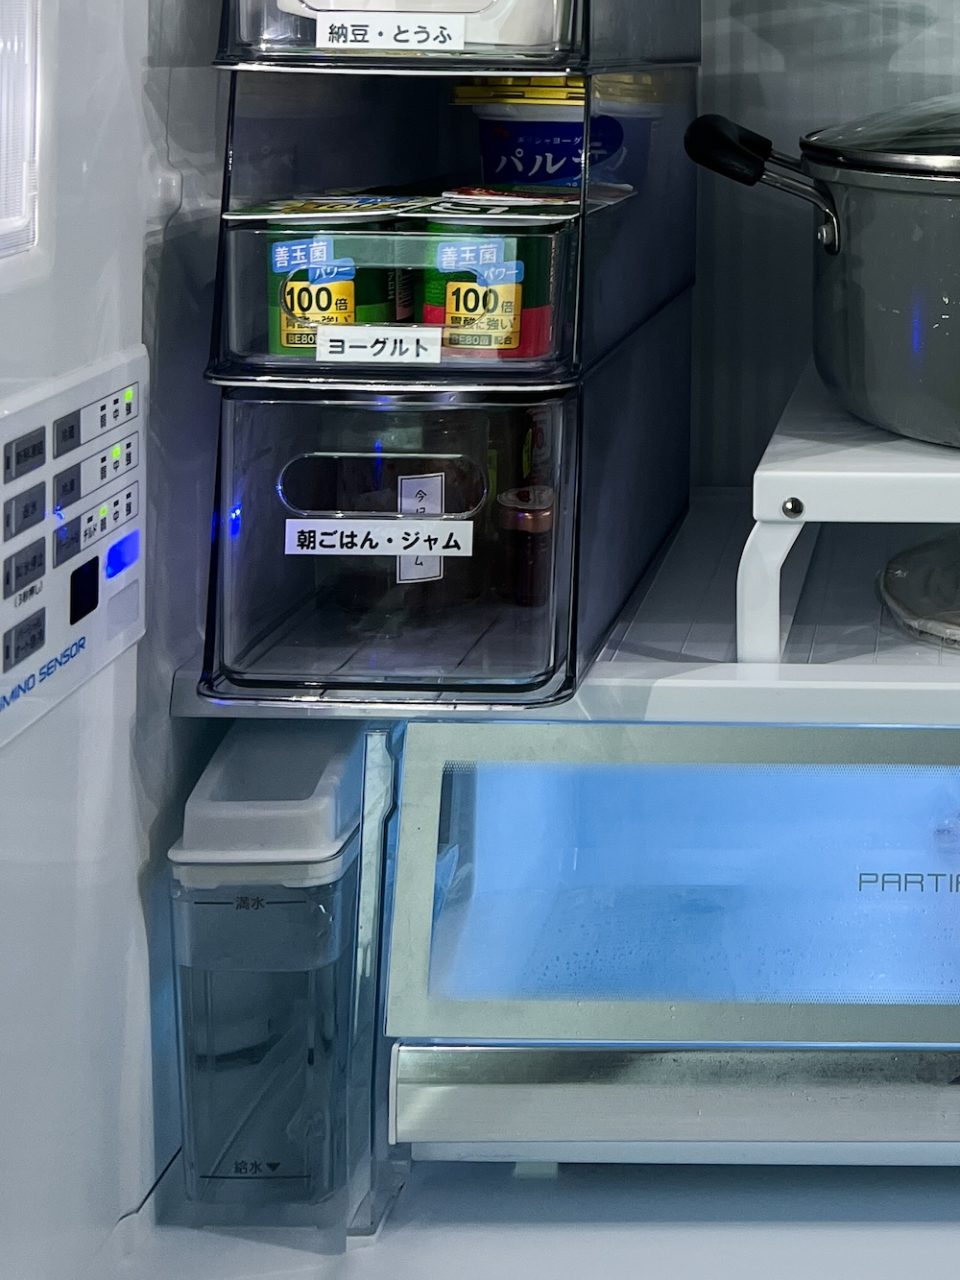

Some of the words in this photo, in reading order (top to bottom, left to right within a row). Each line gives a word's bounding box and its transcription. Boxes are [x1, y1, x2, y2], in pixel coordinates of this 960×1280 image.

[327, 23, 453, 45] 納豆・とうふ
[274, 241, 328, 268] 善玉菌
[440, 243, 499, 269] 善玉菌
[314, 266, 351, 279] パワー
[484, 267, 519, 280] パワー
[328, 337, 429, 359] ヨーグルト
[297, 529, 462, 552] 朝ごはん・ジャム
[38, 636, 86, 683] SENSOR
